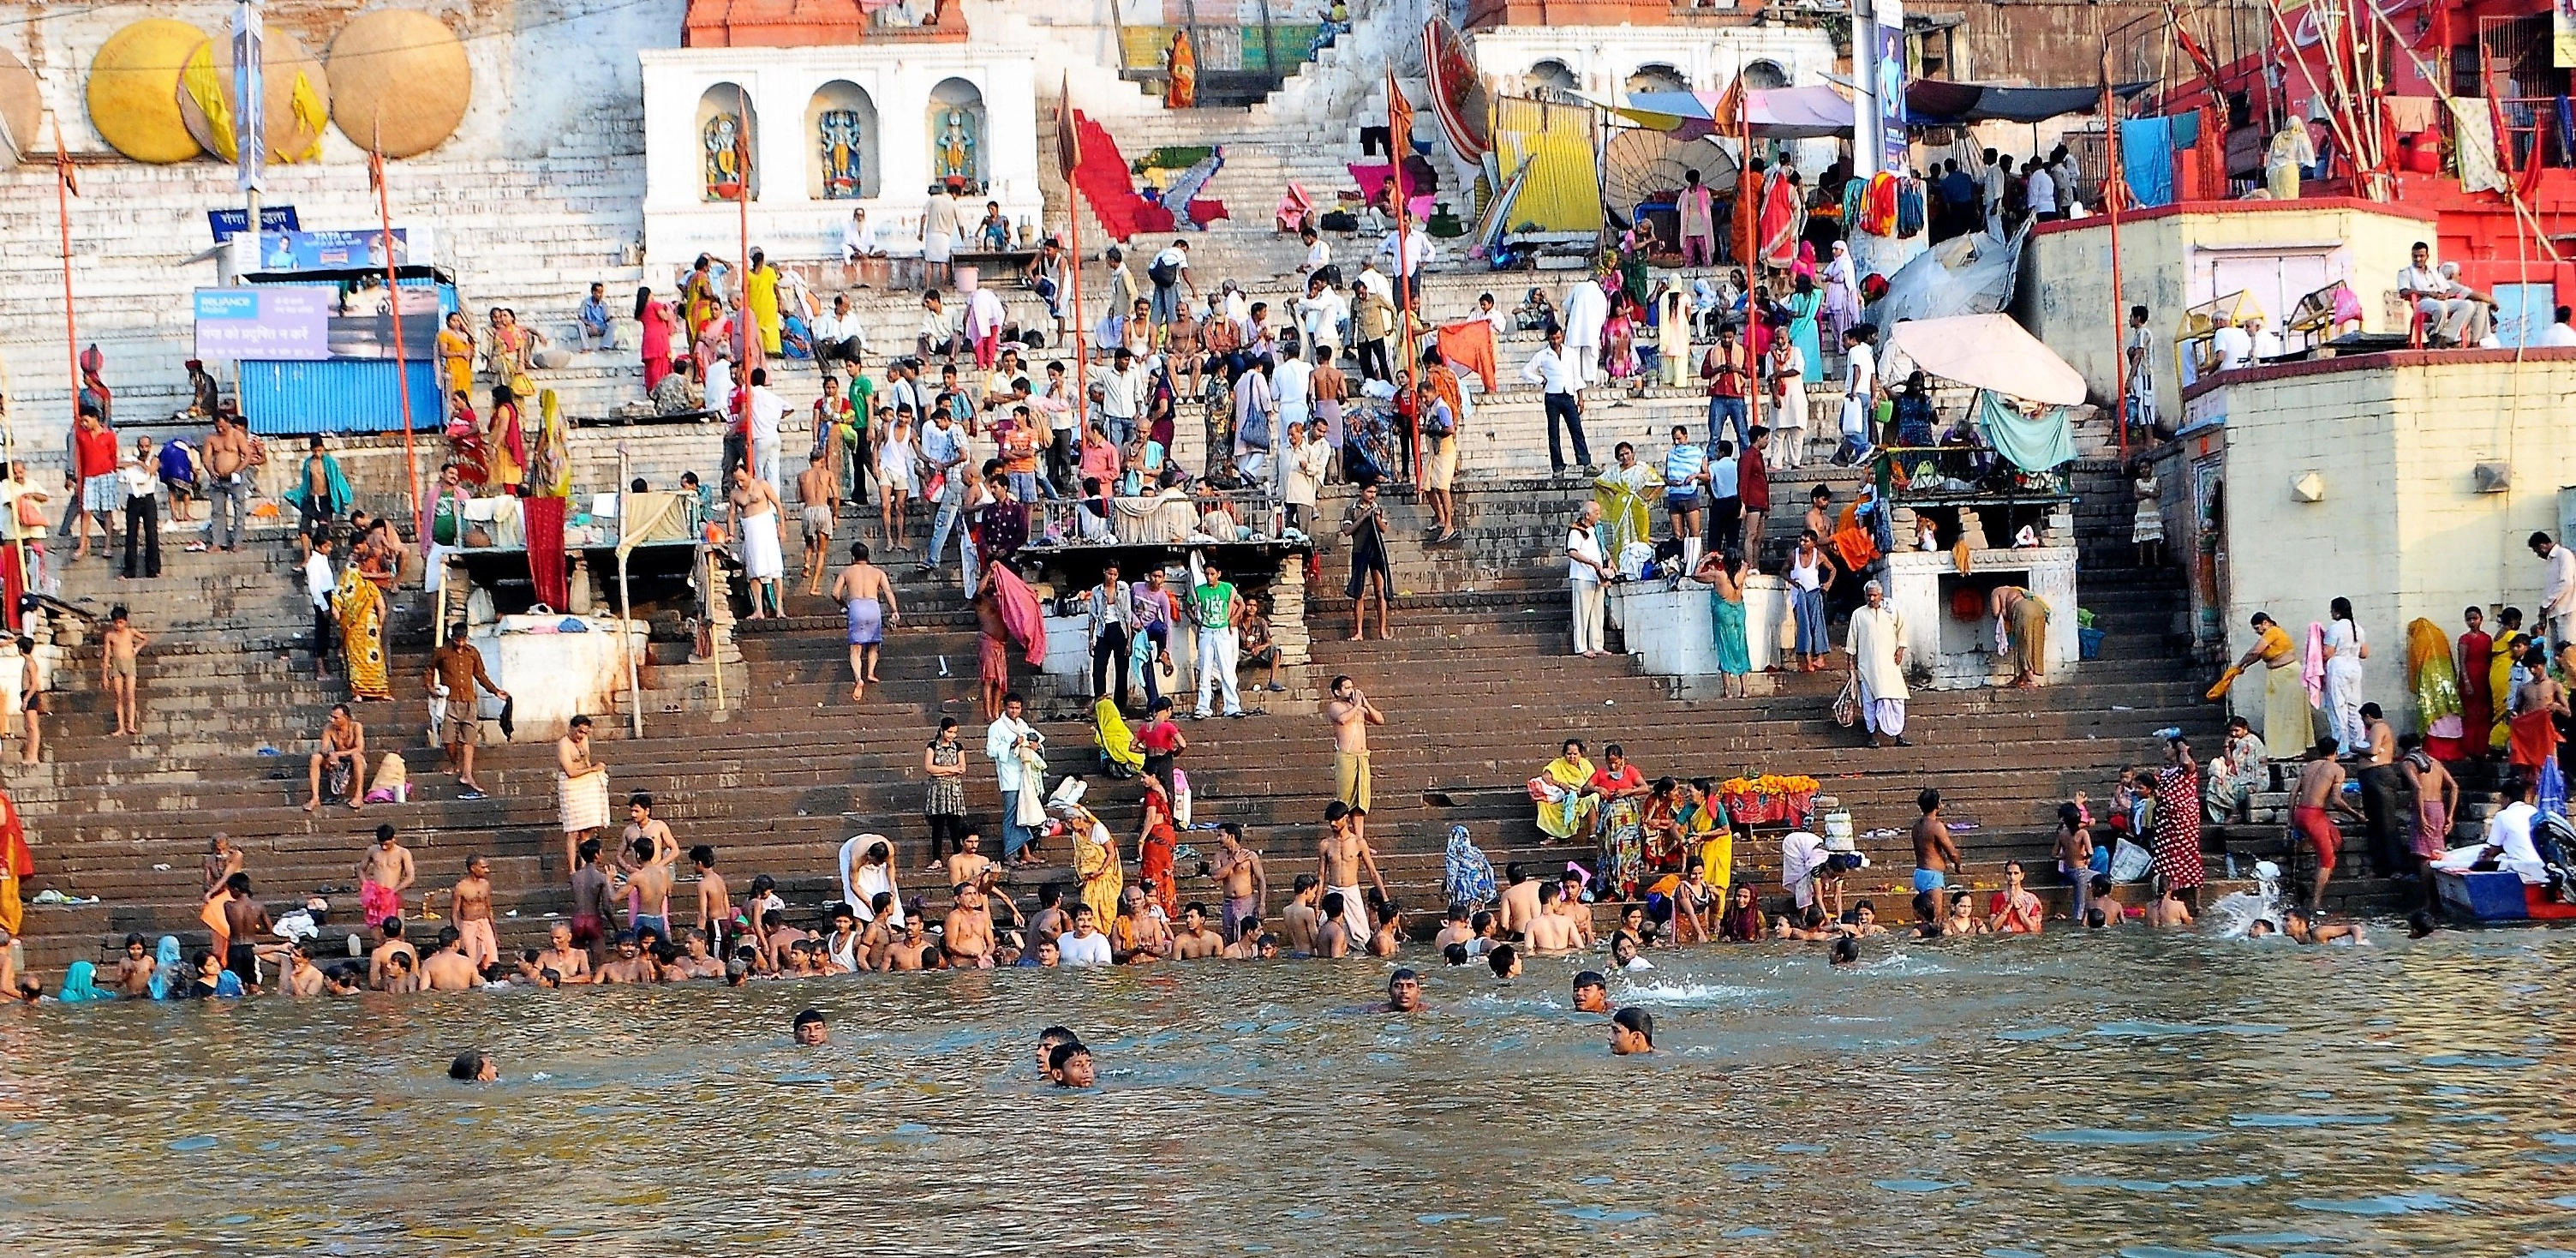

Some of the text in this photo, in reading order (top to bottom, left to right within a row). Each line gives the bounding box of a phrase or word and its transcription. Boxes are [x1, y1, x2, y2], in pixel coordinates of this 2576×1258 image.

[220, 213, 245, 225] गंगा
[201, 325, 309, 343] गंगा को प्रदूषित न करें
